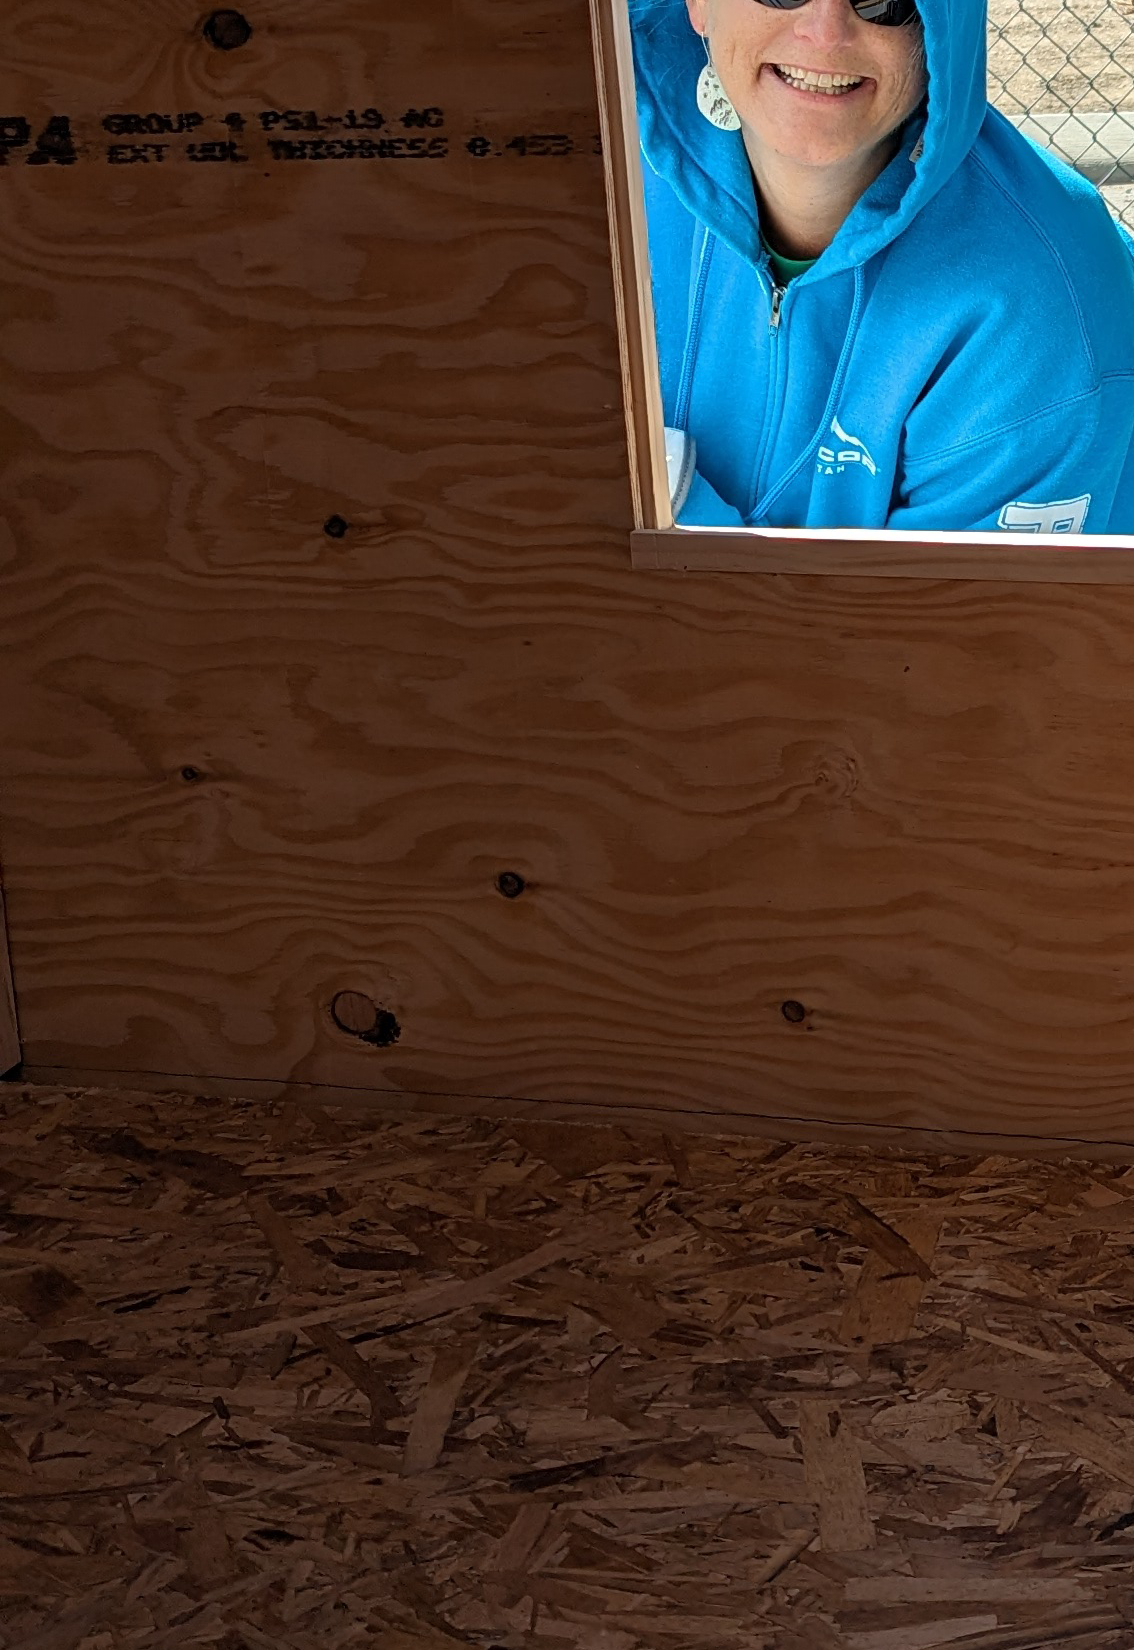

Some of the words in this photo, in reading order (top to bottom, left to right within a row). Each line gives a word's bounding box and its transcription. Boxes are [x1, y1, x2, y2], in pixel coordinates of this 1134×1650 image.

[103, 112, 203, 135] GROUP
[107, 144, 169, 163] EXT
[267, 137, 448, 160] THICKNESS
